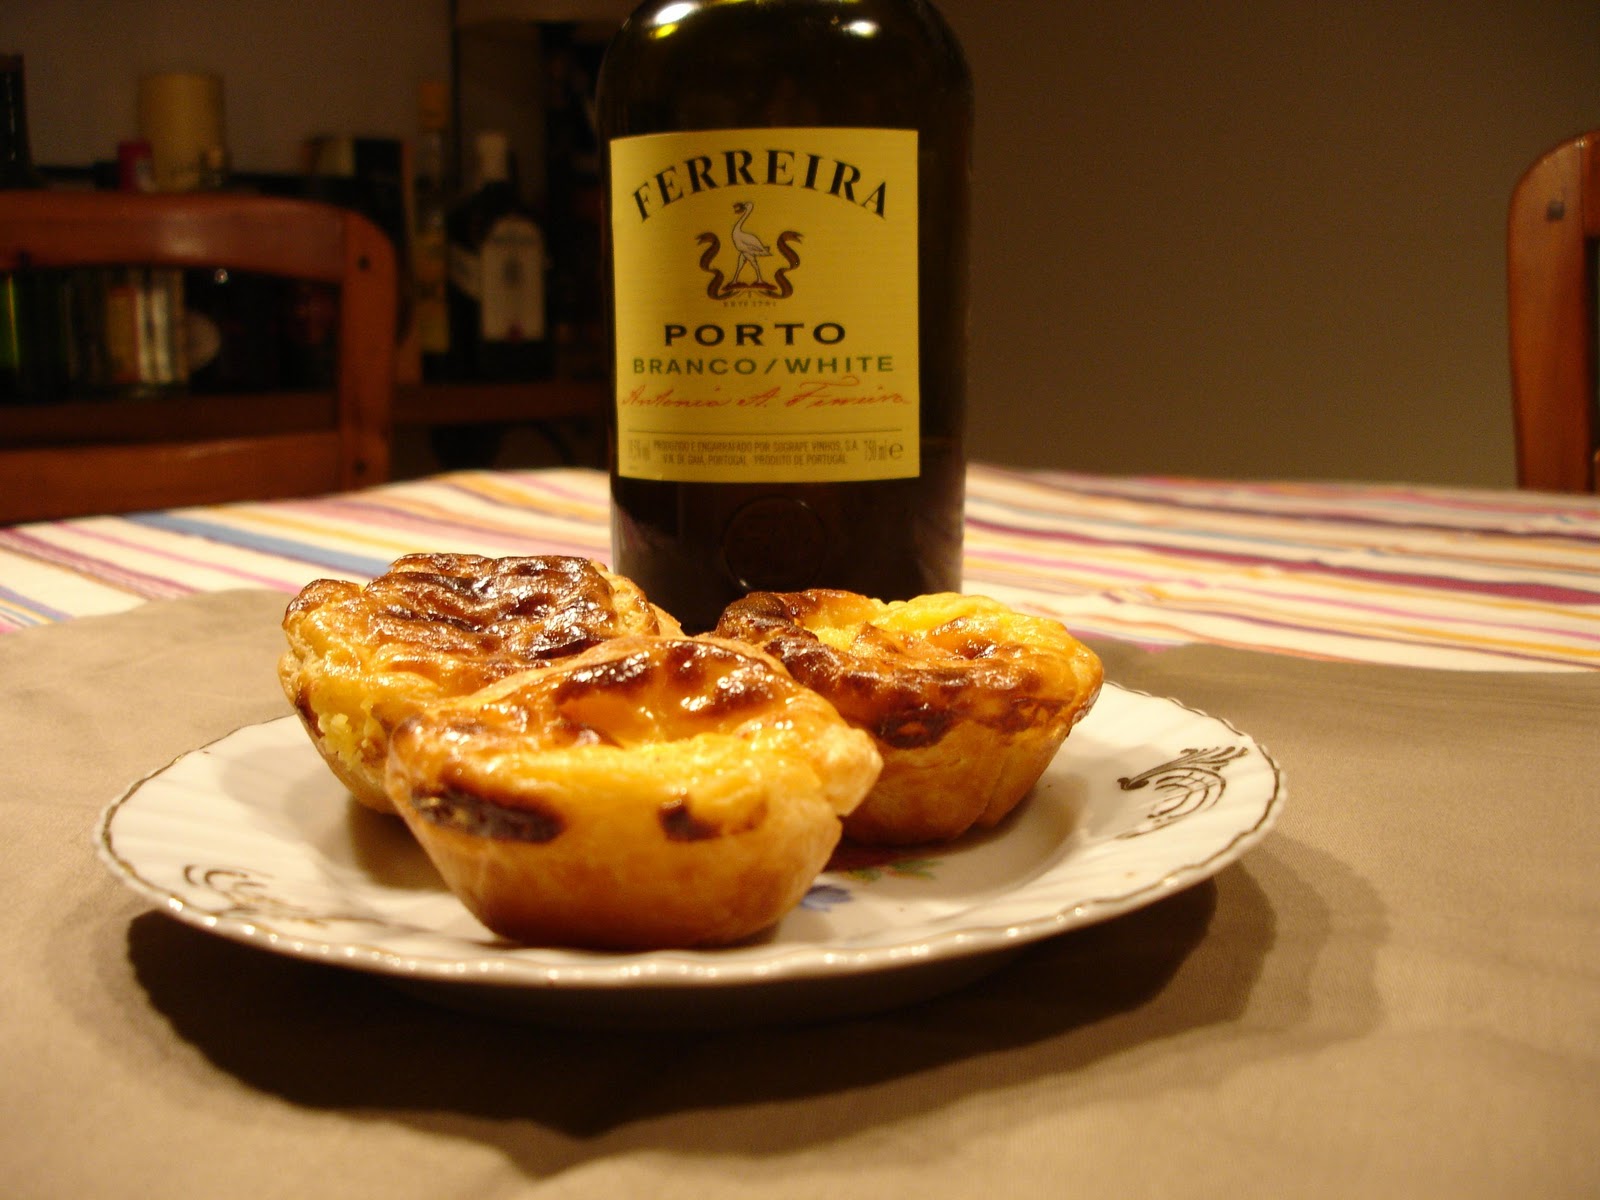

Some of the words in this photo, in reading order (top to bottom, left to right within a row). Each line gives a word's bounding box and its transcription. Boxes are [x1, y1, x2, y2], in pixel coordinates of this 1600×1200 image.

[632, 149, 887, 223] FERREIRA
[664, 322, 846, 346] PORTO
[632, 355, 894, 376] BRANCO/WHITE
